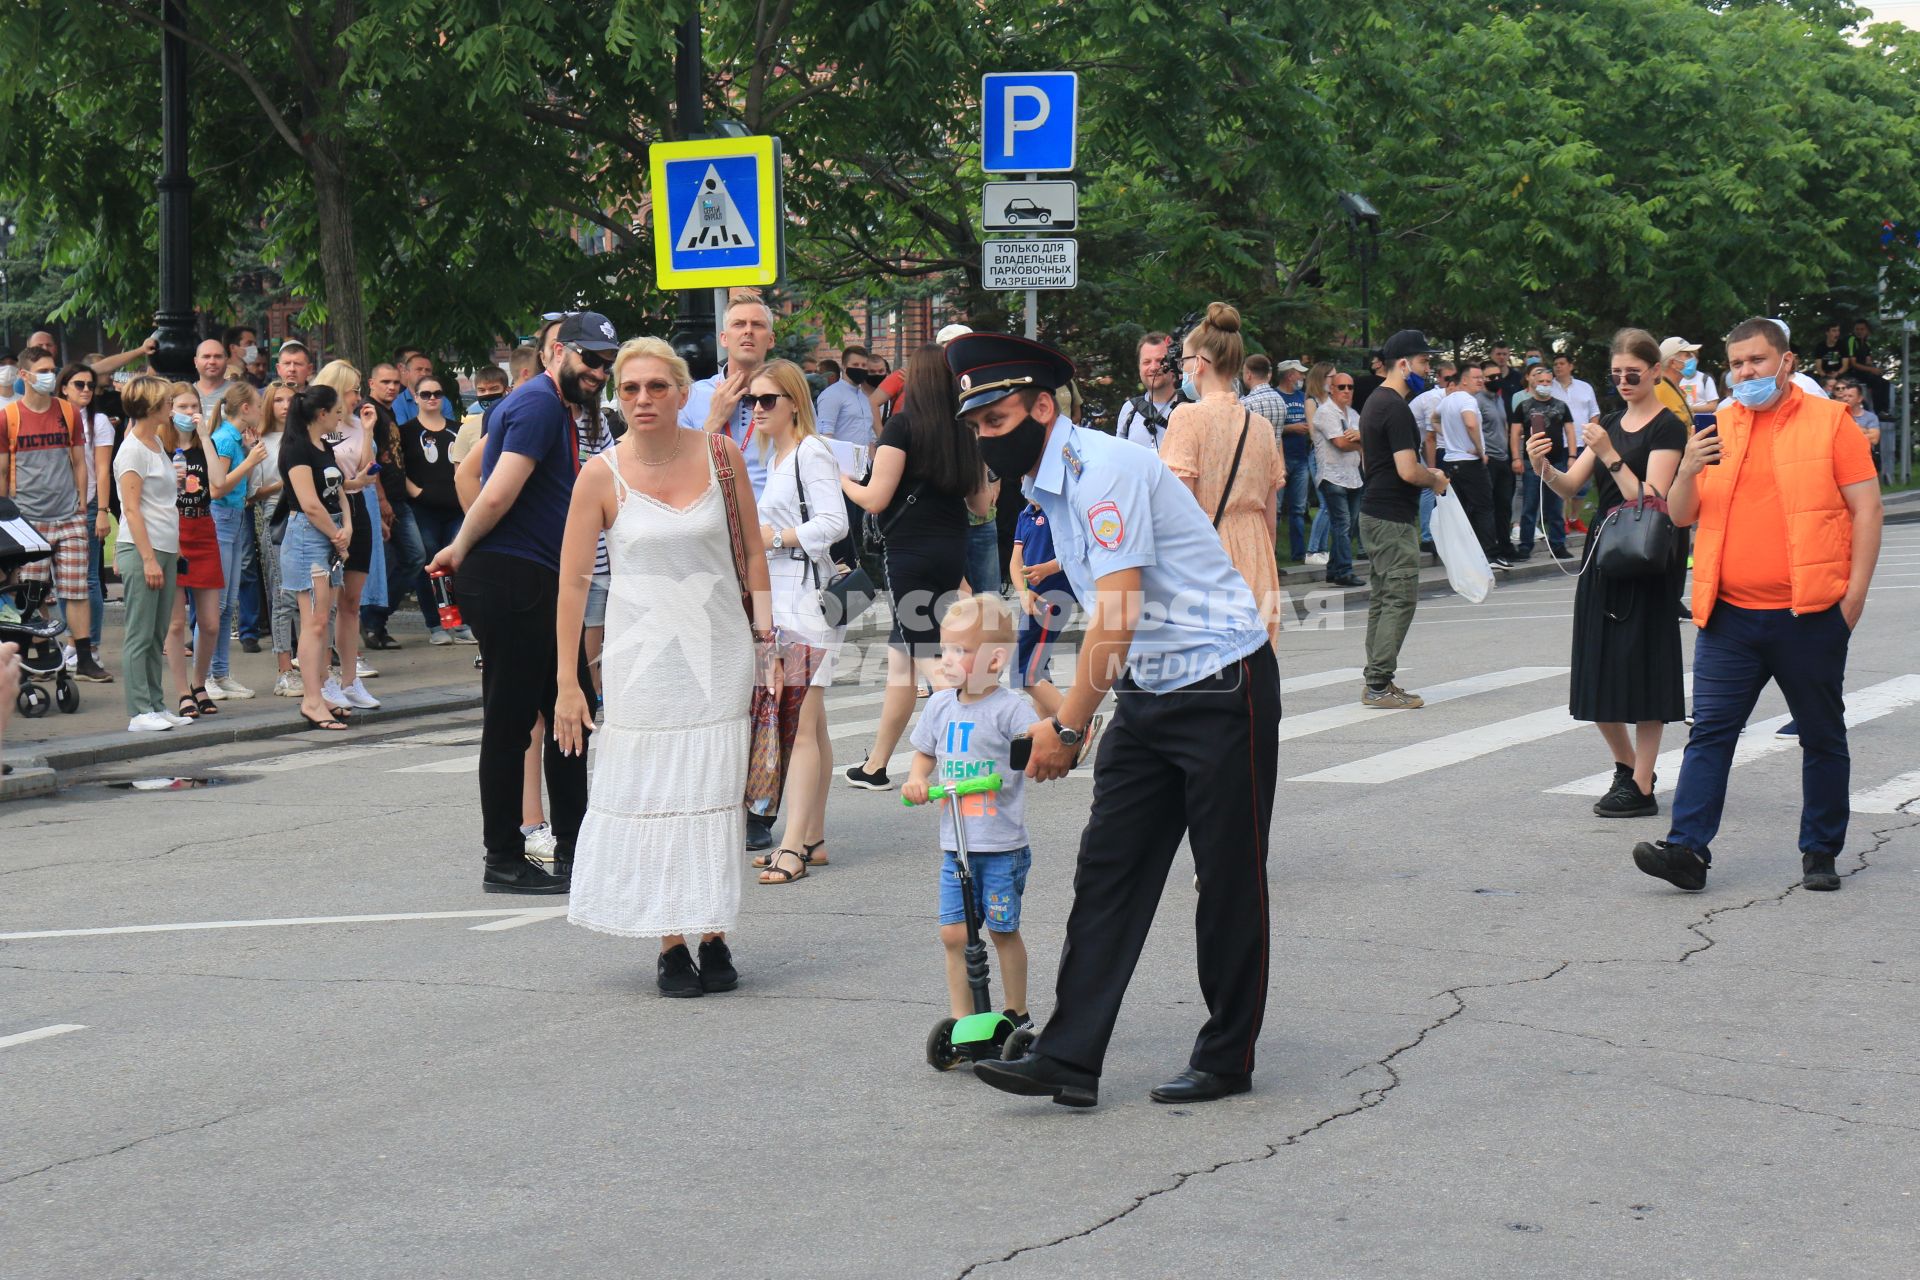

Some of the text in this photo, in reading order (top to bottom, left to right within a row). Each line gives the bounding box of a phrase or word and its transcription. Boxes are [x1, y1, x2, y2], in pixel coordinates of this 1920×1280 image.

[1003, 86, 1050, 157] P
[996, 243, 1064, 253] ТОЛЬКО ДЛЯ
[994, 254, 1067, 265] ВЛАДЕЛЬЦЕВ
[990, 265, 1072, 275] ПАРКОВОЧНЫХ
[994, 275, 1067, 286] РАЗРЕШЕНИЙ
[946, 721, 975, 753] IT
[943, 760, 996, 779] ASN'T
